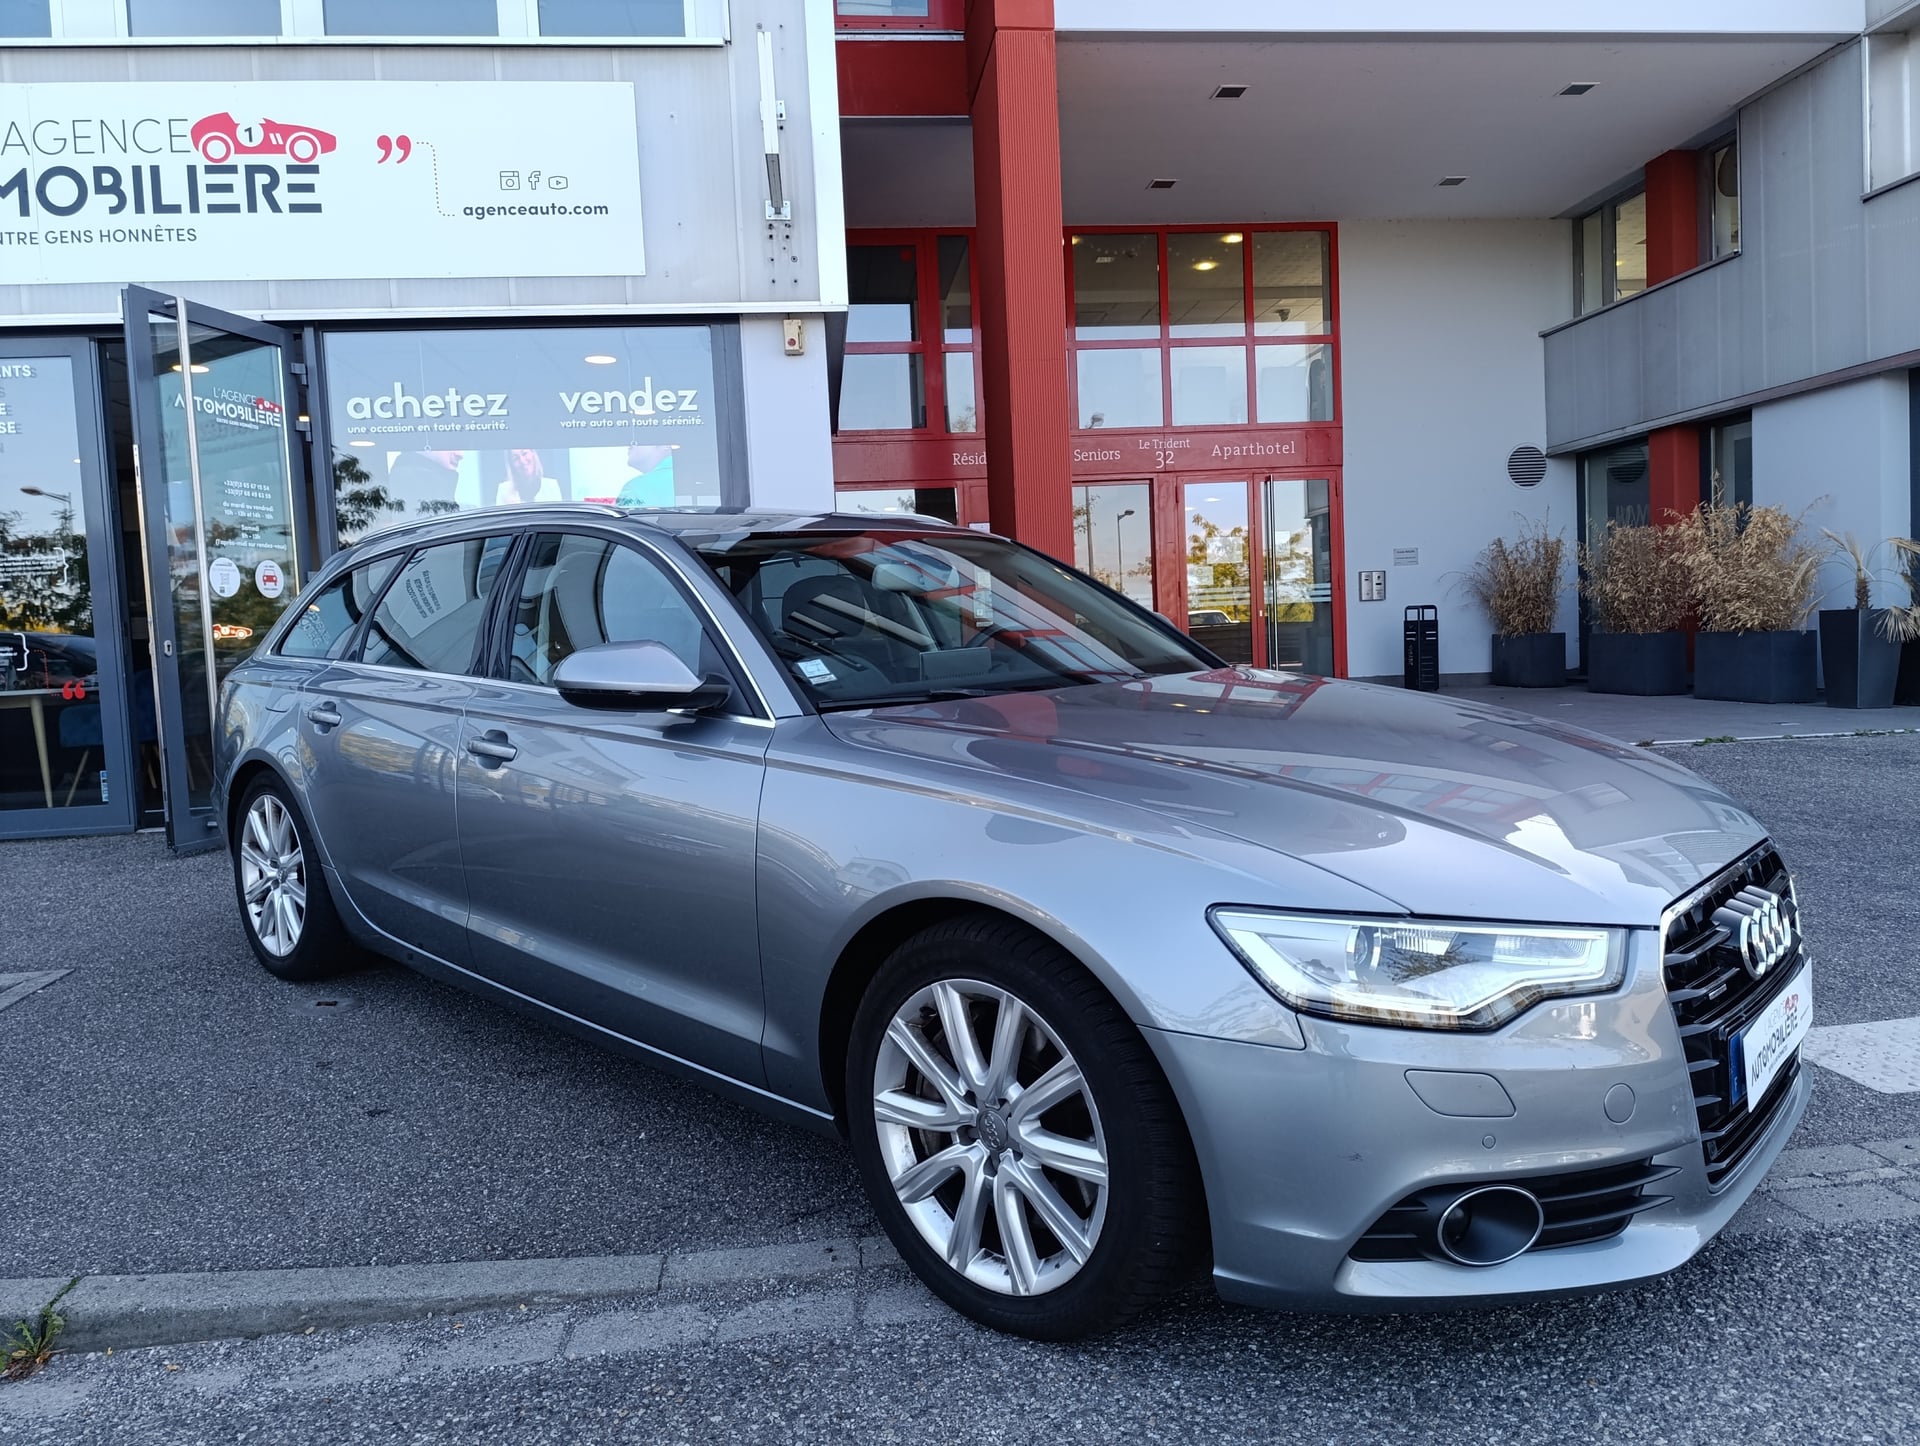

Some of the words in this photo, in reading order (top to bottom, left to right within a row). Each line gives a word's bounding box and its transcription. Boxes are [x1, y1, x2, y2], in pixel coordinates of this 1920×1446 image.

[0, 118, 192, 156] AGENCE
[463, 202, 609, 220] agenceauto.com
[0, 230, 40, 246] TRE
[45, 229, 94, 245] GENS
[99, 224, 198, 244] HONNÊTES
[0, 364, 32, 378] NTS
[212, 387, 258, 407] L'AGENCE
[346, 381, 509, 420] achetez
[559, 376, 698, 415] vendez
[174, 393, 282, 427] ATOMOBILIERE
[347, 426, 367, 434] une
[370, 423, 415, 433] occasion
[417, 424, 431, 432] en
[433, 422, 462, 431] toute
[464, 420, 509, 431] sécurité.
[560, 418, 586, 428] votre
[589, 418, 614, 427] auto
[616, 419, 629, 427] en
[632, 417, 659, 426] toute
[662, 415, 705, 426] sérénité.
[1139, 439, 1151, 450] Le
[1152, 438, 1191, 449] Trident
[1211, 441, 1296, 460] Aparthotel
[1073, 448, 1121, 462] Seniors
[1155, 451, 1175, 469] 32
